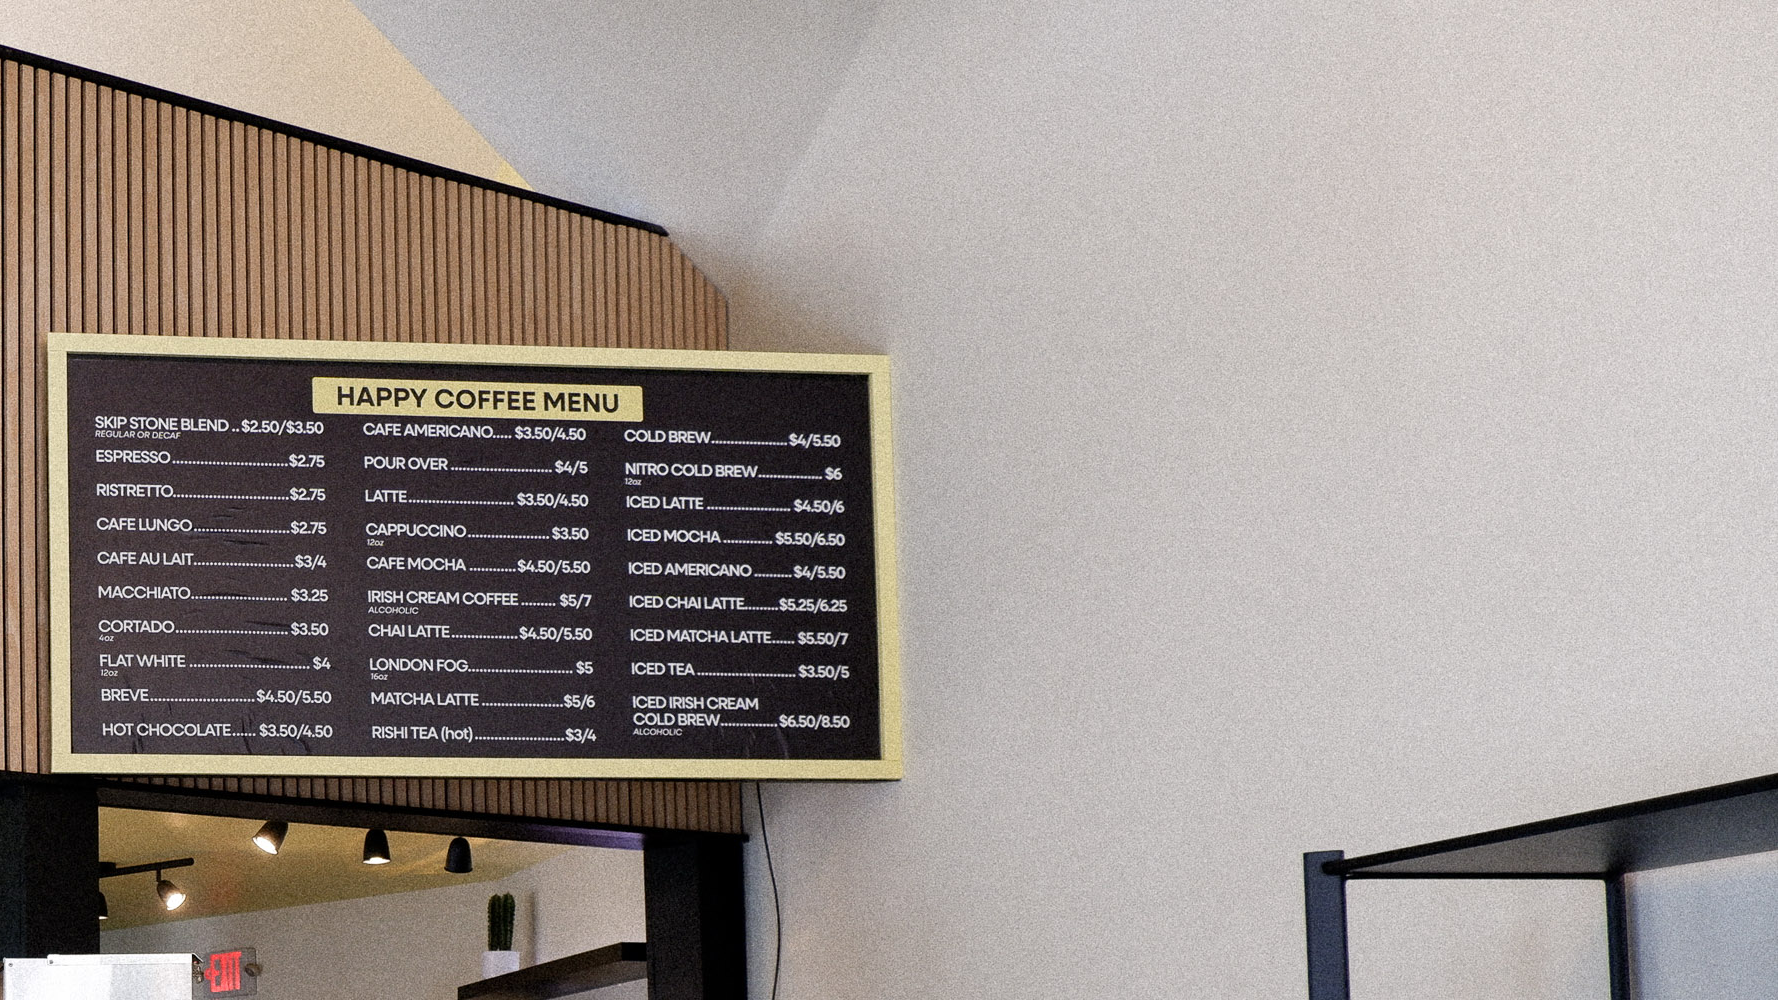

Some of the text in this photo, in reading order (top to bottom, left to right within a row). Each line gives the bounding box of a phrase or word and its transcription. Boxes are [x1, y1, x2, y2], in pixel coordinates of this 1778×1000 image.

[338, 386, 619, 413] HAPPY COFFEE MENU
[95, 416, 324, 435] SKIP STONE BLEND $2.50/$3.50
[95, 430, 135, 438] REGULAR
[152, 432, 181, 440] DECAF
[96, 450, 325, 468] ESPRESSO $2.75
[364, 456, 588, 475] POUR OVER $4/5
[626, 463, 842, 480] NITRO COLD BREW $6
[626, 496, 844, 514] ICED LATTE $4.50/6
[628, 529, 845, 548] ICED MOCHA $5.50/6.50
[367, 556, 590, 575] CAFE MOCHA $4.50/5.50
[628, 562, 846, 580] ICED AMERICANO $4/5.50
[368, 590, 592, 609] IRISH CREAM COFFEE $5/7
[98, 620, 328, 636] CORTADO $3.50
[100, 654, 331, 670] FLAT WHITE $4
[632, 662, 849, 679] ICED TEA $3.50/5
[371, 692, 595, 710] MATCHA LATTE $5/6
[632, 696, 758, 710] ICED IRISH CREAM
[633, 713, 850, 730] COLD BREW $6.50/8.50
[103, 724, 332, 739] HOT CHOCOLATE $3.50/4.50
[633, 728, 682, 736] ALCOHOLIC
[210, 951, 242, 993] EXIT
